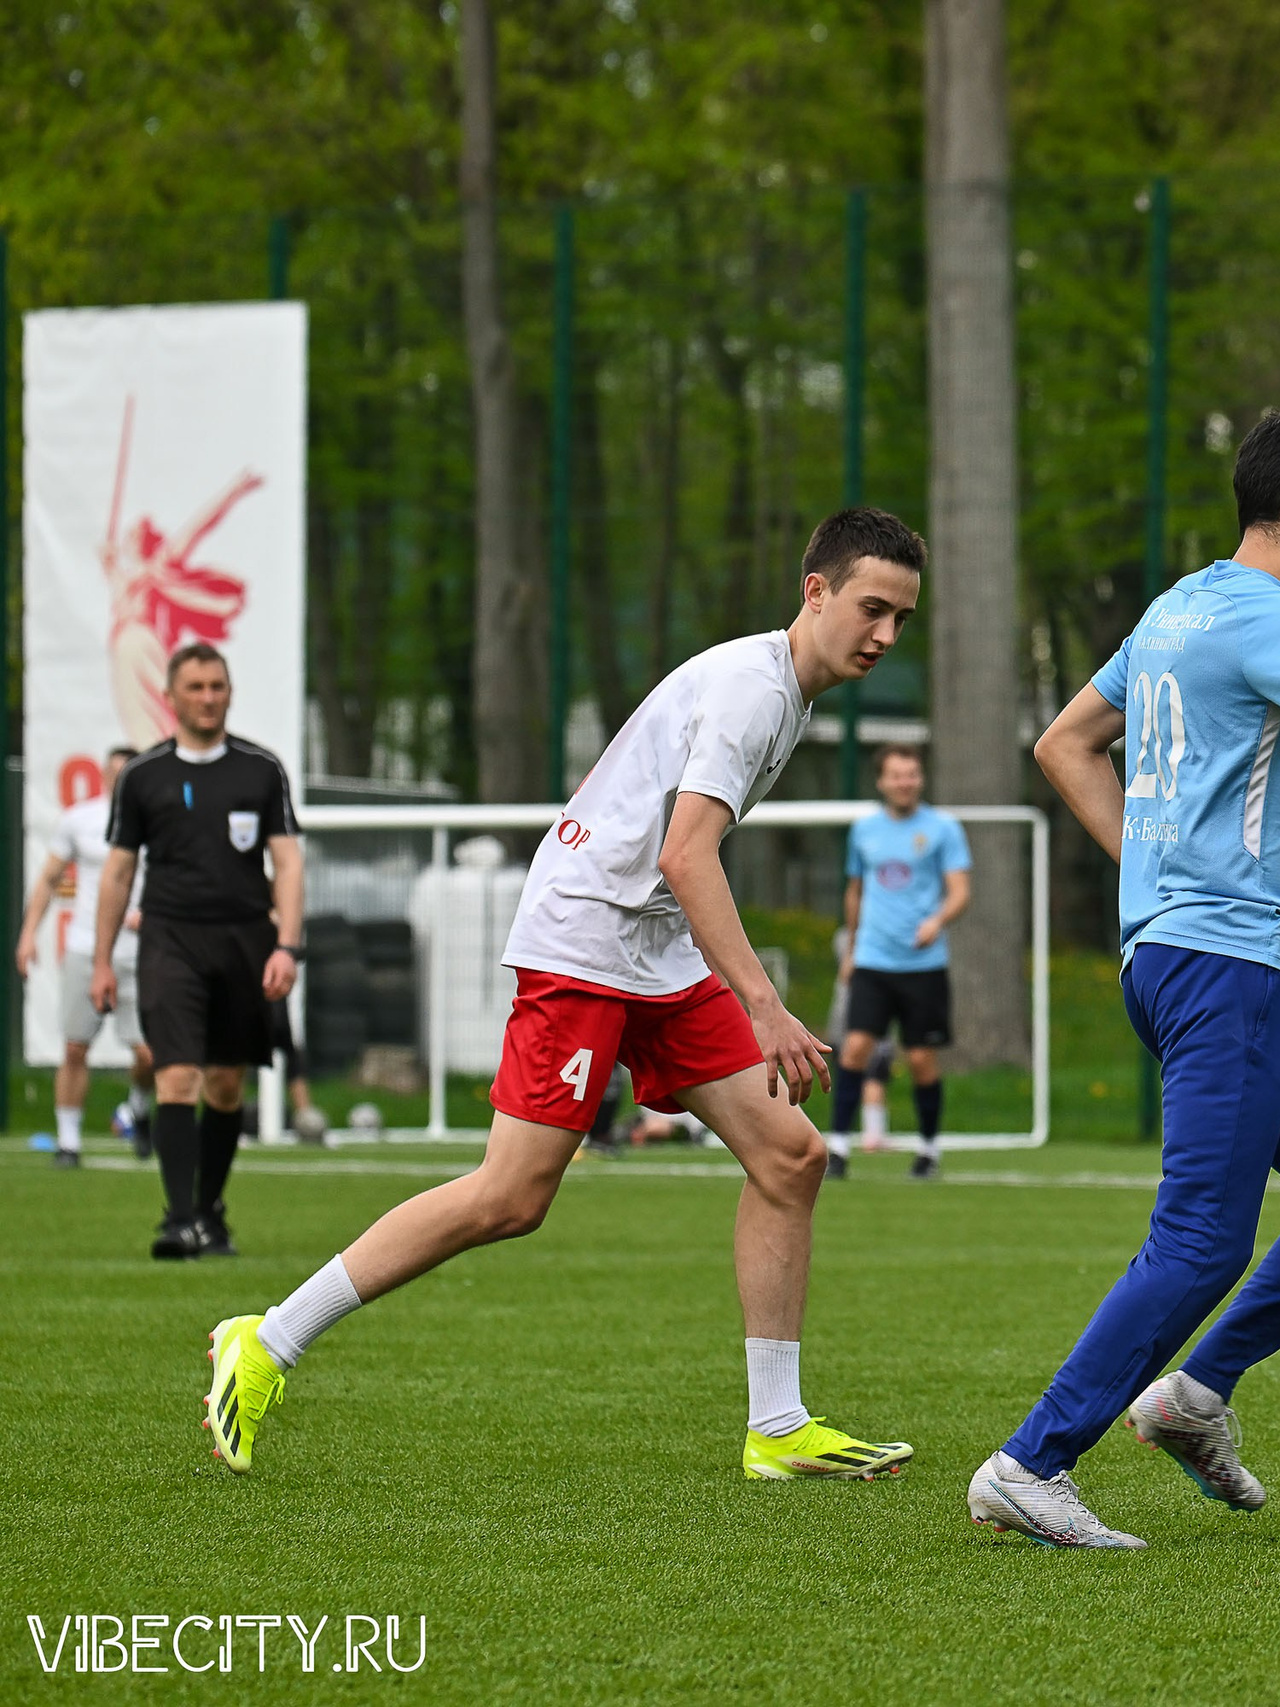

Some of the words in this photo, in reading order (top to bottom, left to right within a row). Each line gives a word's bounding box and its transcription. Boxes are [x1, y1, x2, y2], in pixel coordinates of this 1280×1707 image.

[1125, 671, 1186, 801] 20
[557, 811, 591, 851] ОР
[559, 1048, 593, 1102] 4
